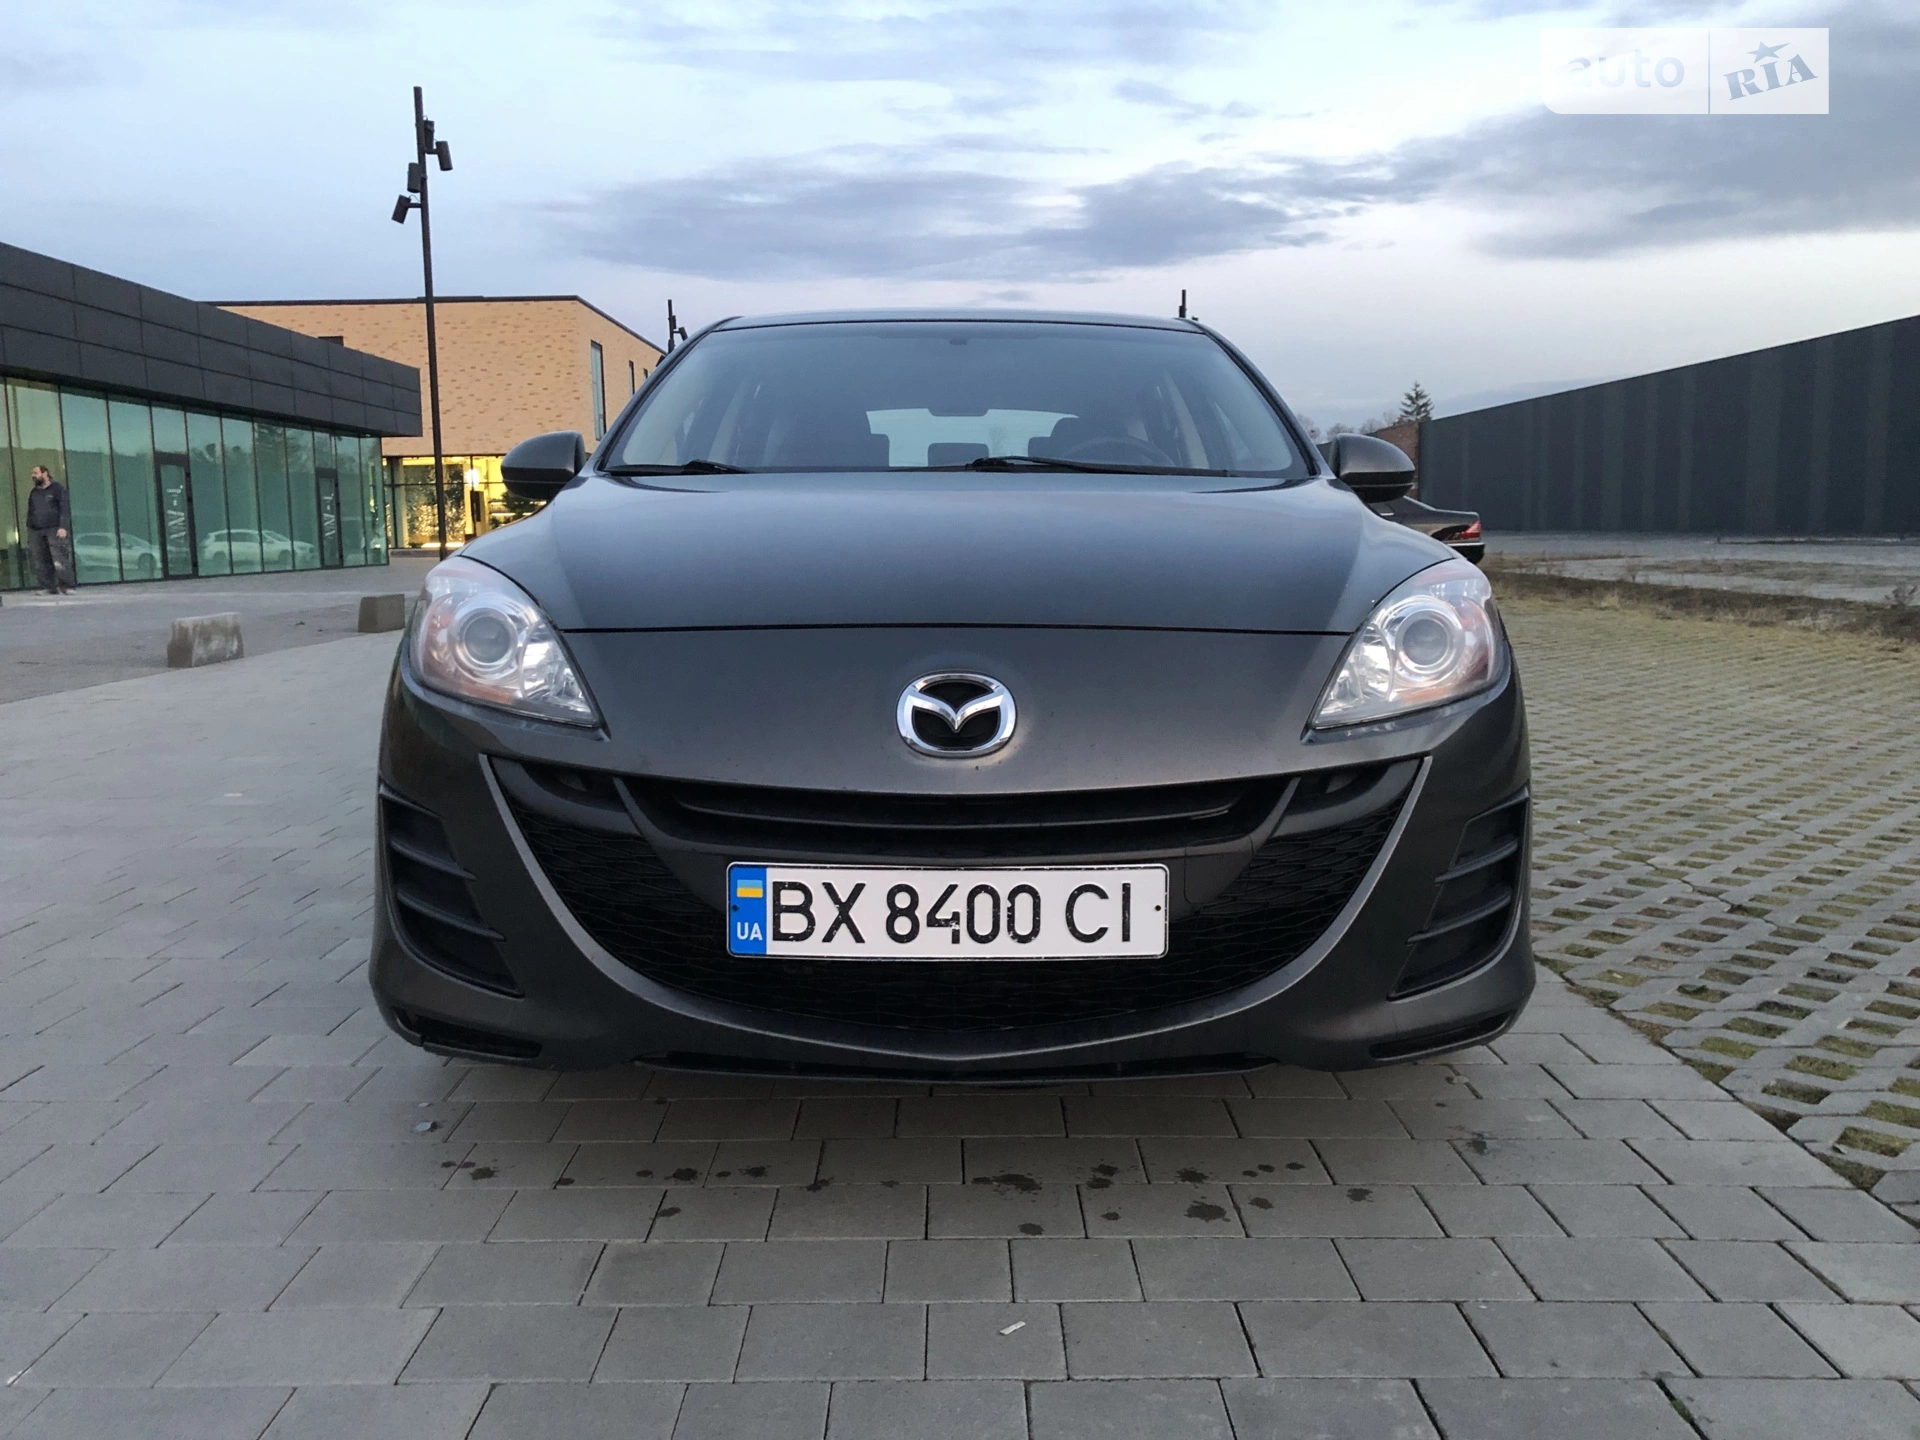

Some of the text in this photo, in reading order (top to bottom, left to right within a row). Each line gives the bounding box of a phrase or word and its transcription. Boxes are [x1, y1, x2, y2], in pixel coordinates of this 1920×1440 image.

[736, 921, 763, 941] UA
[771, 880, 1132, 945] BX 8400 CI
